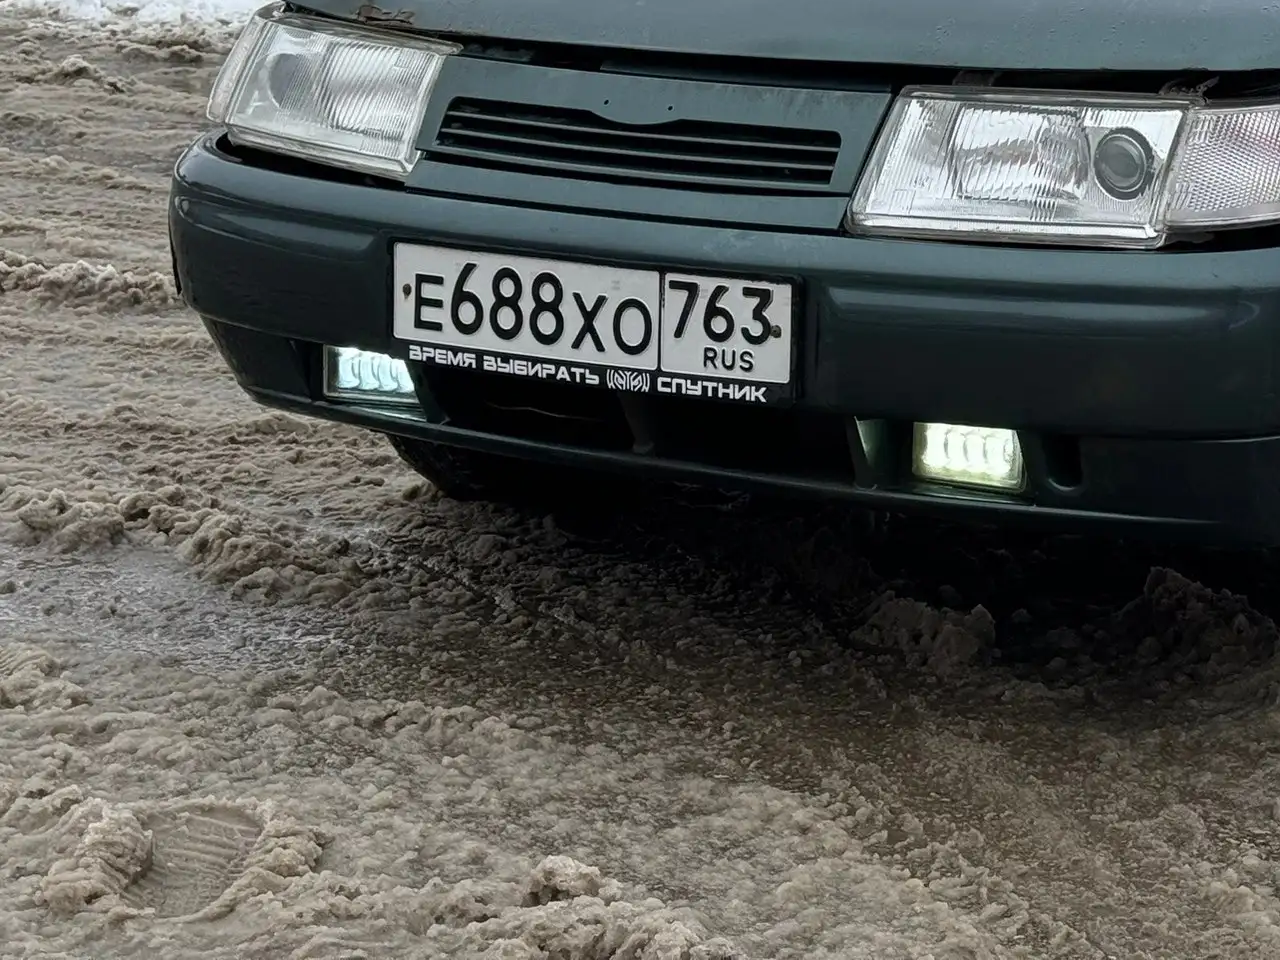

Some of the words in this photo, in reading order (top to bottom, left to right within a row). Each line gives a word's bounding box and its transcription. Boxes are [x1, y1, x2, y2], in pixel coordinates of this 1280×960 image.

[414, 262, 653, 356] Е688ХО
[668, 279, 774, 345] 763
[408, 344, 477, 369] ВРЕМЯ
[482, 355, 600, 385] ВЫБИРАТЬ
[656, 376, 768, 403] СПУТНИК
[703, 346, 755, 372] RUS
